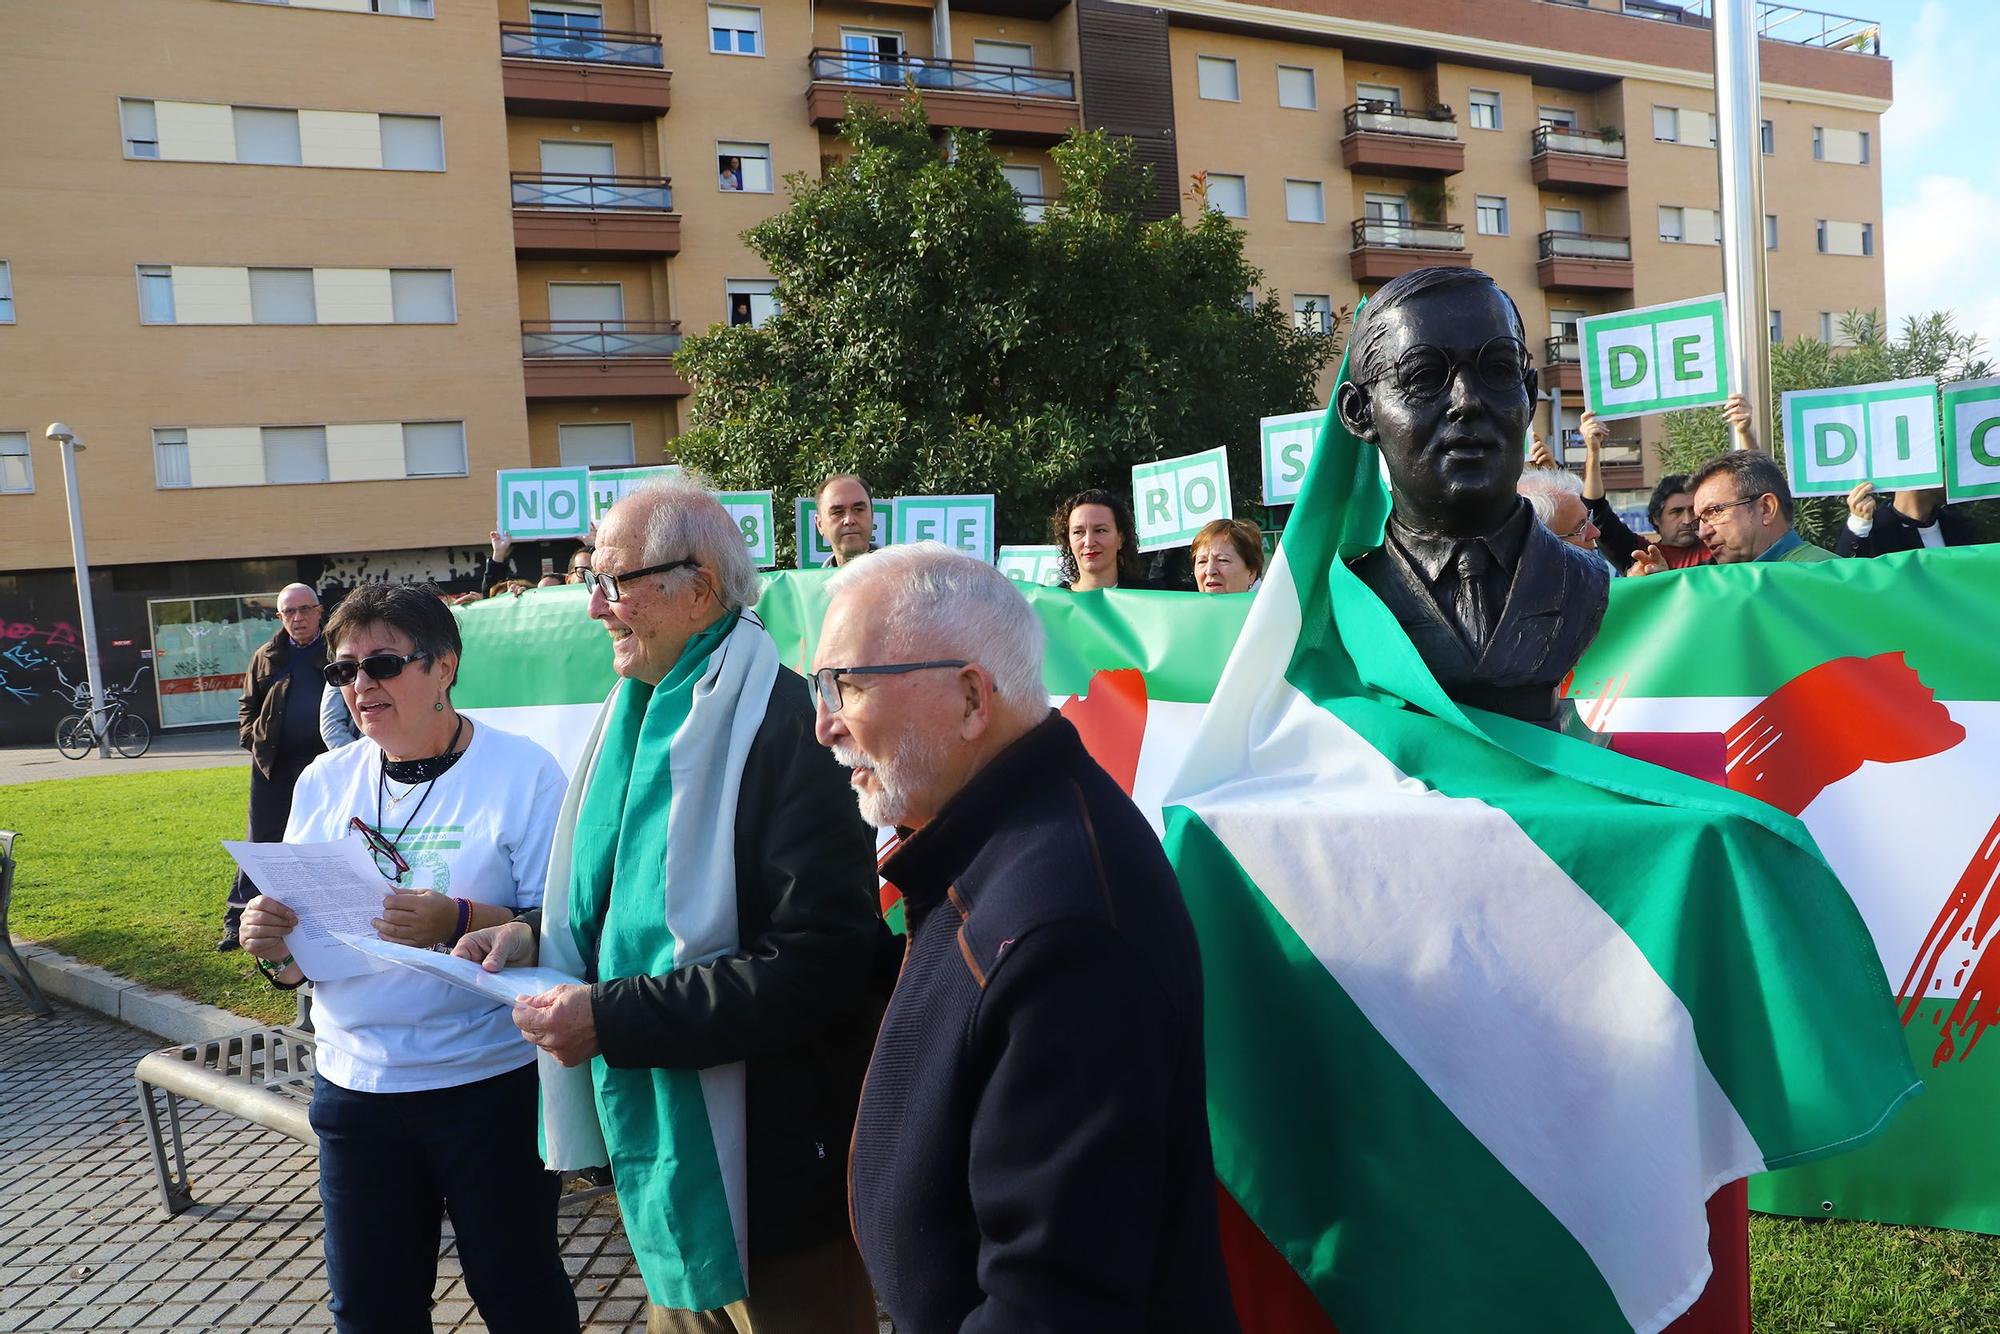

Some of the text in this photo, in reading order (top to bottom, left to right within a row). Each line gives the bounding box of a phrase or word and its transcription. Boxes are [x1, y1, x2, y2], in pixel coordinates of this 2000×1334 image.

[1607, 334, 1703, 390] DE
[1813, 415, 1910, 467] DI
[1281, 444, 1306, 482] S
[513, 490, 576, 520] NO
[594, 491, 613, 520] H
[1145, 476, 1217, 525] RO
[740, 515, 760, 548] 8
